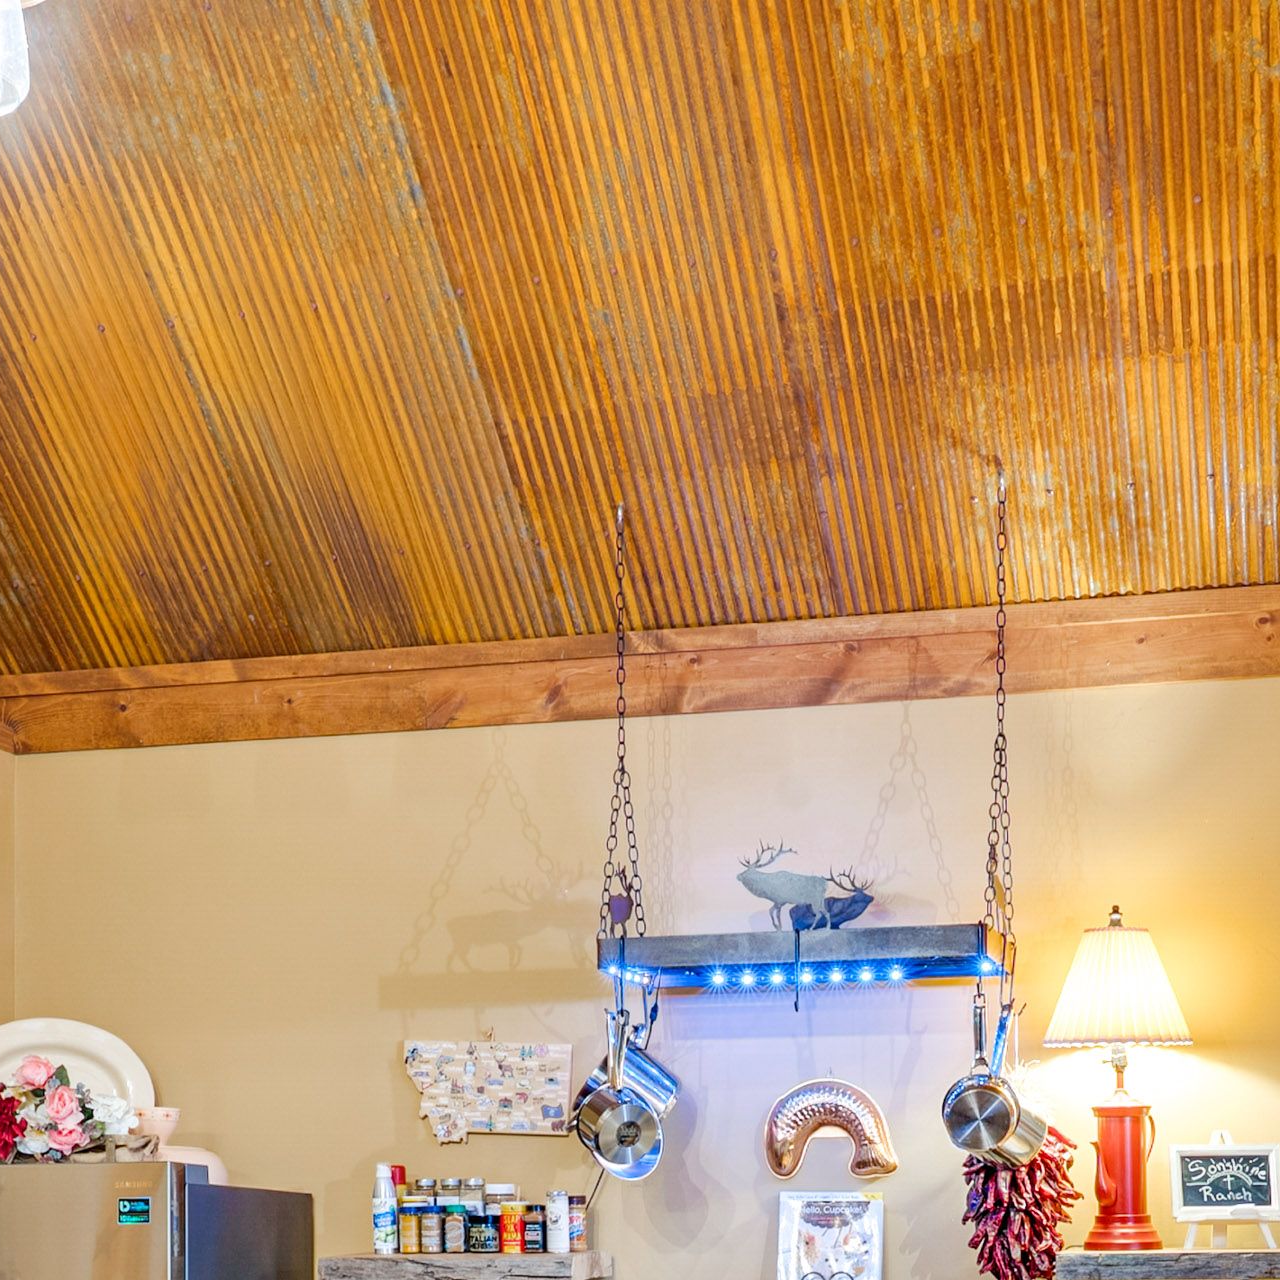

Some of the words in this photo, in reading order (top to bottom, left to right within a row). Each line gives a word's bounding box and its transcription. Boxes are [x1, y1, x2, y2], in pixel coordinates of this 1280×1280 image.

[1187, 1157, 1267, 1181] Sonshine
[1198, 1185, 1253, 1203] Ranch
[802, 1205, 821, 1215] ello,
